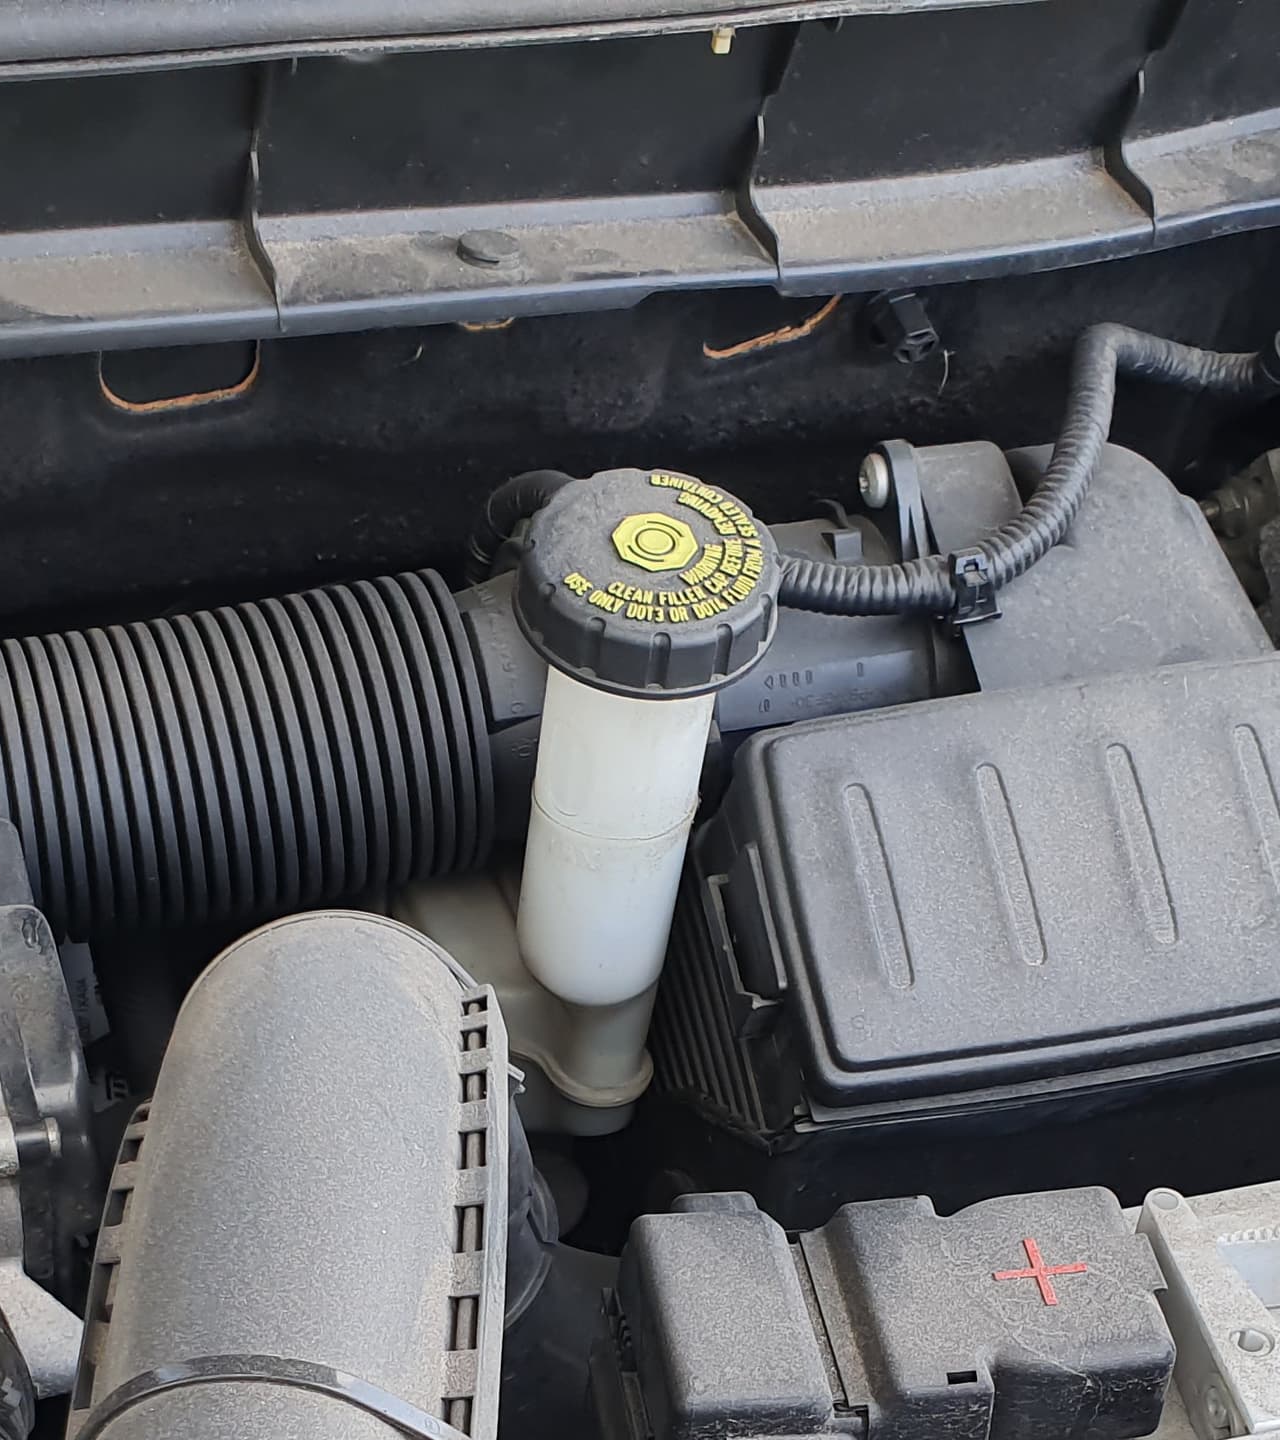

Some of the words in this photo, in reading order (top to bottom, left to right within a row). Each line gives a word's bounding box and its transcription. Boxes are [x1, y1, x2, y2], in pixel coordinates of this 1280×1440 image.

[650, 473, 723, 505] CONTAINER
[677, 491, 737, 536] REMOVING
[722, 501, 758, 539] SEALED
[679, 543, 723, 587] WARNING
[720, 536, 745, 578] BEFORE
[741, 547, 764, 580] FROM
[563, 572, 594, 597] USE
[606, 581, 654, 606] CLEAN
[658, 586, 707, 607] FILLER
[704, 571, 730, 595] CAP
[722, 571, 757, 607] FLUID
[588, 587, 626, 615] ONLY
[626, 602, 665, 623] DOT3
[669, 604, 689, 623] OR
[693, 597, 728, 621] DOT4
